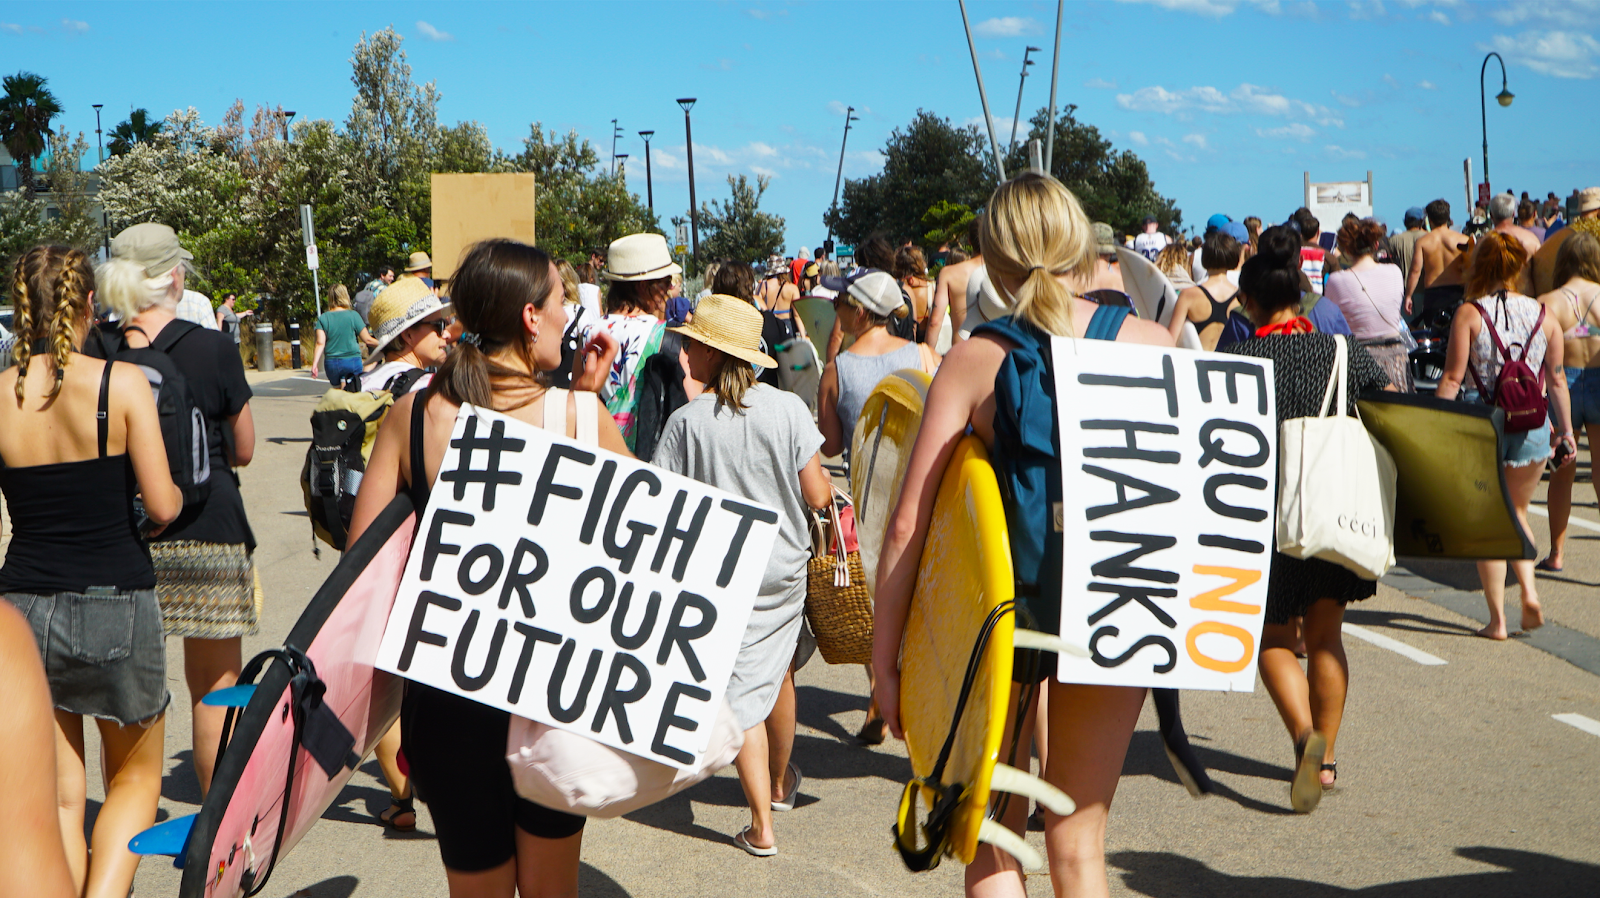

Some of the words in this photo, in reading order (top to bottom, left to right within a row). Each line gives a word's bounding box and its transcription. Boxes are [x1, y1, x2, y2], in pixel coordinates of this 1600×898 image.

[440, 414, 779, 588] #FIGHT
[1077, 354, 1181, 675] THANKS
[396, 590, 712, 766] FUTURE
[419, 508, 550, 619] FOR
[569, 565, 718, 683] OUR
